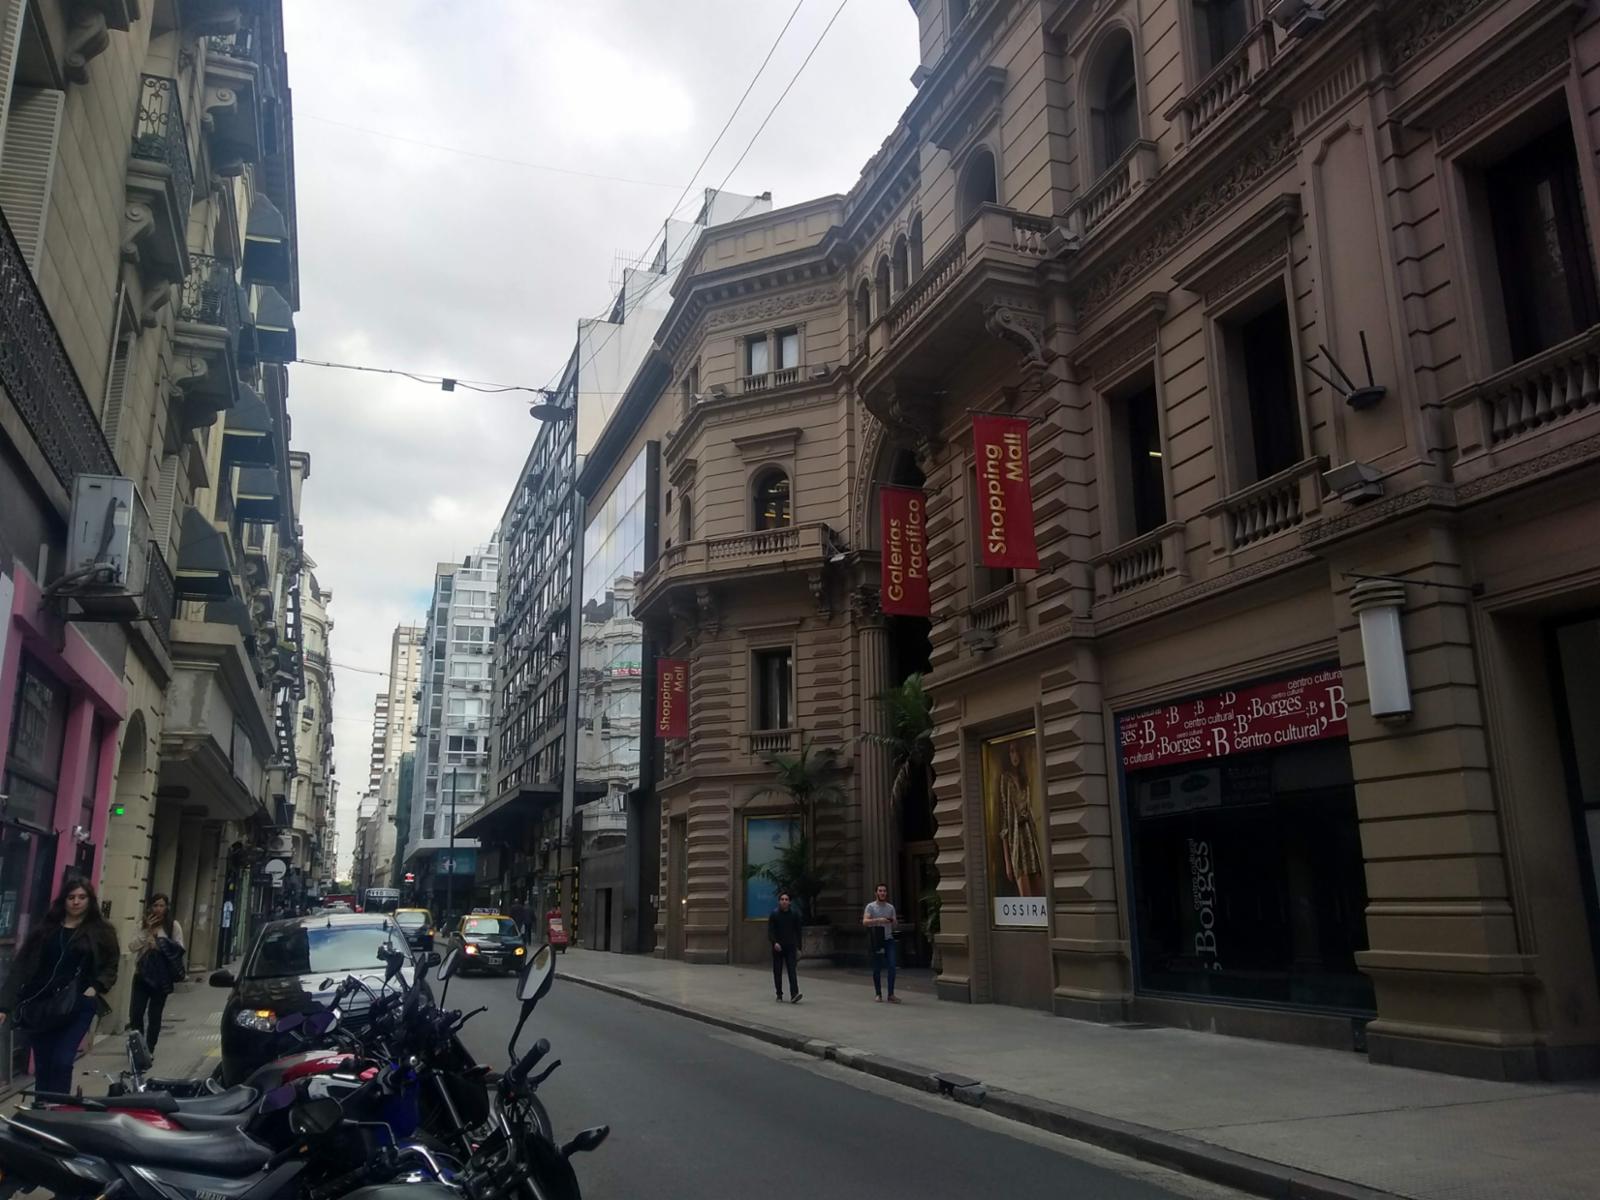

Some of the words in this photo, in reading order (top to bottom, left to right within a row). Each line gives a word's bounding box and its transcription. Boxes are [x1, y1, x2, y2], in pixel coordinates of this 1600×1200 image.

[1004, 433, 1023, 482] Mall
[983, 444, 1006, 554] Shopping
[906, 499, 922, 579] Pacífico
[886, 518, 903, 601] Galerías
[674, 666, 685, 692] Mall
[1287, 676, 1313, 689] centro
[660, 673, 673, 731] Shopping
[1166, 706, 1179, 728] ;B
[1184, 717, 1207, 729] centro
[1207, 708, 1234, 724] cultural
[1233, 714, 1249, 738] ;B
[1139, 719, 1156, 749] ;B
[1234, 732, 1272, 749] centro
[1274, 718, 1320, 743] cultural
[1129, 749, 1154, 764] cultural
[1003, 903, 1047, 917] OSSIRA
